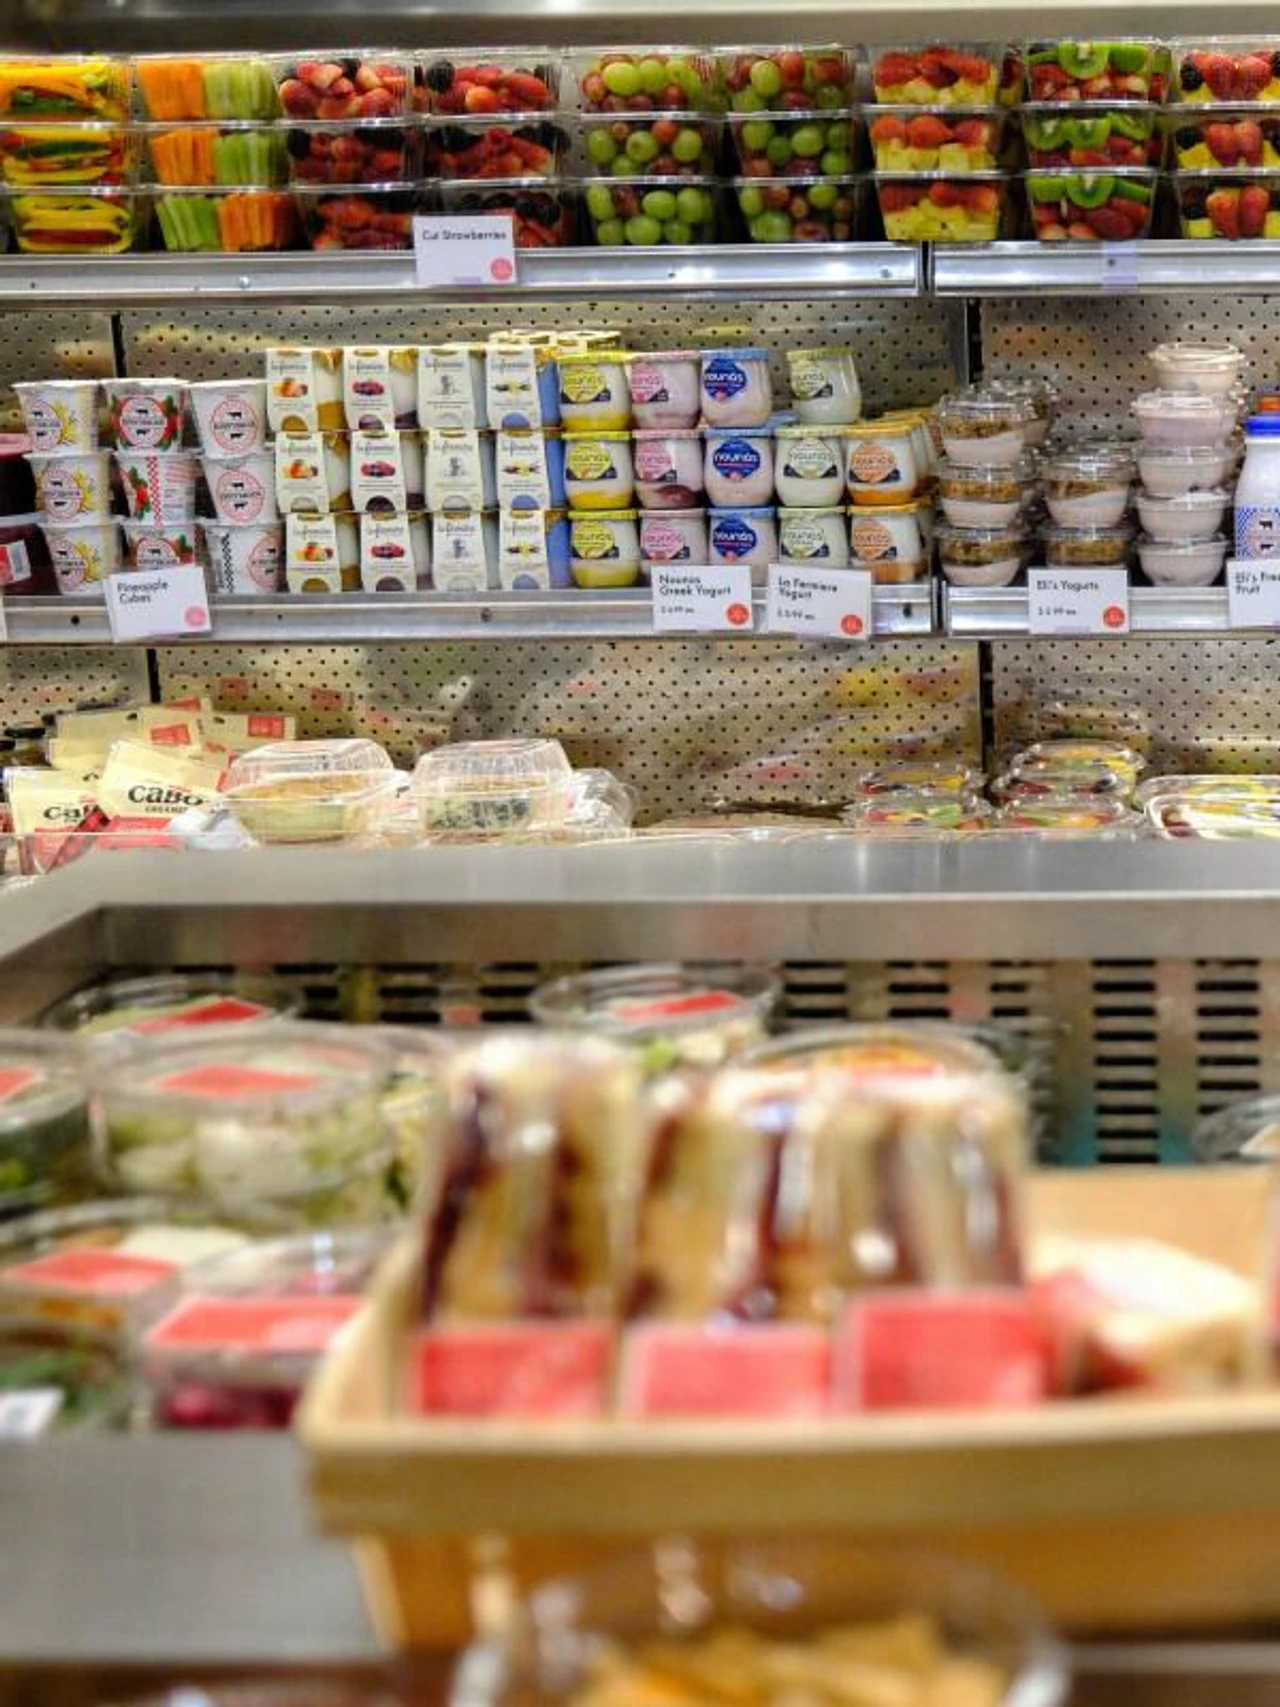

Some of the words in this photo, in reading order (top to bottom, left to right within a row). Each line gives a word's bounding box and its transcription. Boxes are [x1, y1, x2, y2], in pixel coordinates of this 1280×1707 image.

[117, 577, 169, 593] Pineapple
[660, 584, 692, 597] Greek
[696, 585, 732, 599] Yogurt
[779, 587, 813, 600] Yogurt
